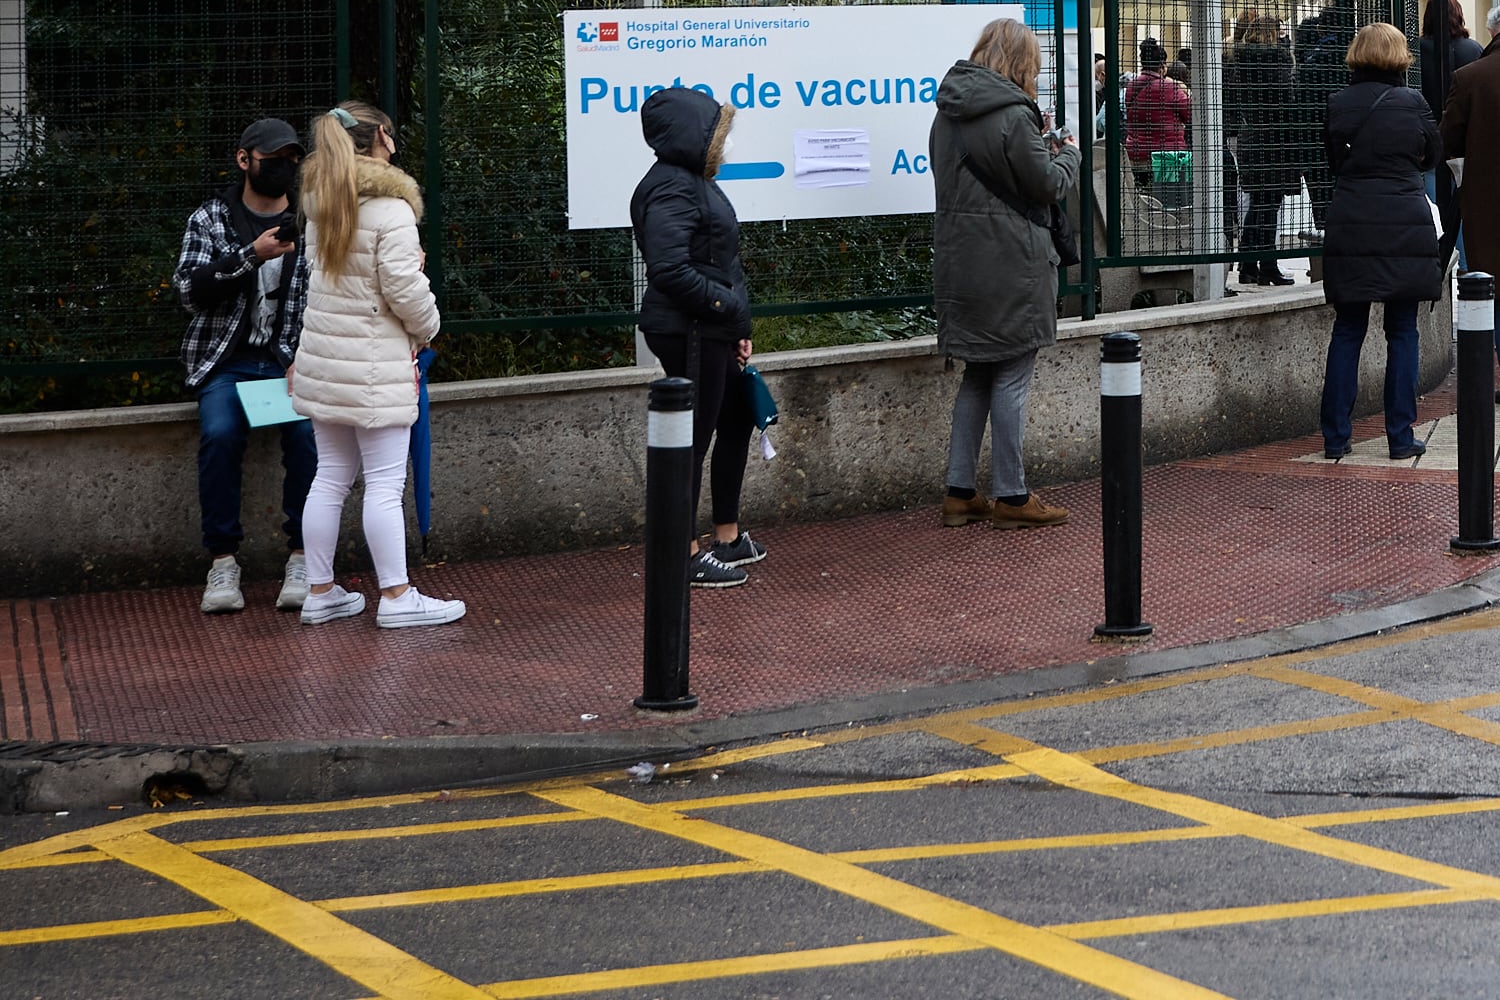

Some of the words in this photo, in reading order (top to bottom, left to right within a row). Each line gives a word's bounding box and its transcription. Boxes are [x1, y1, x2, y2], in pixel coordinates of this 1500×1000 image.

[626, 20, 678, 33] Hospital
[682, 19, 730, 31] General
[734, 18, 810, 30] Universitario
[627, 36, 697, 52] Gregorio
[702, 34, 767, 48] Marañón
[731, 74, 781, 109] de
